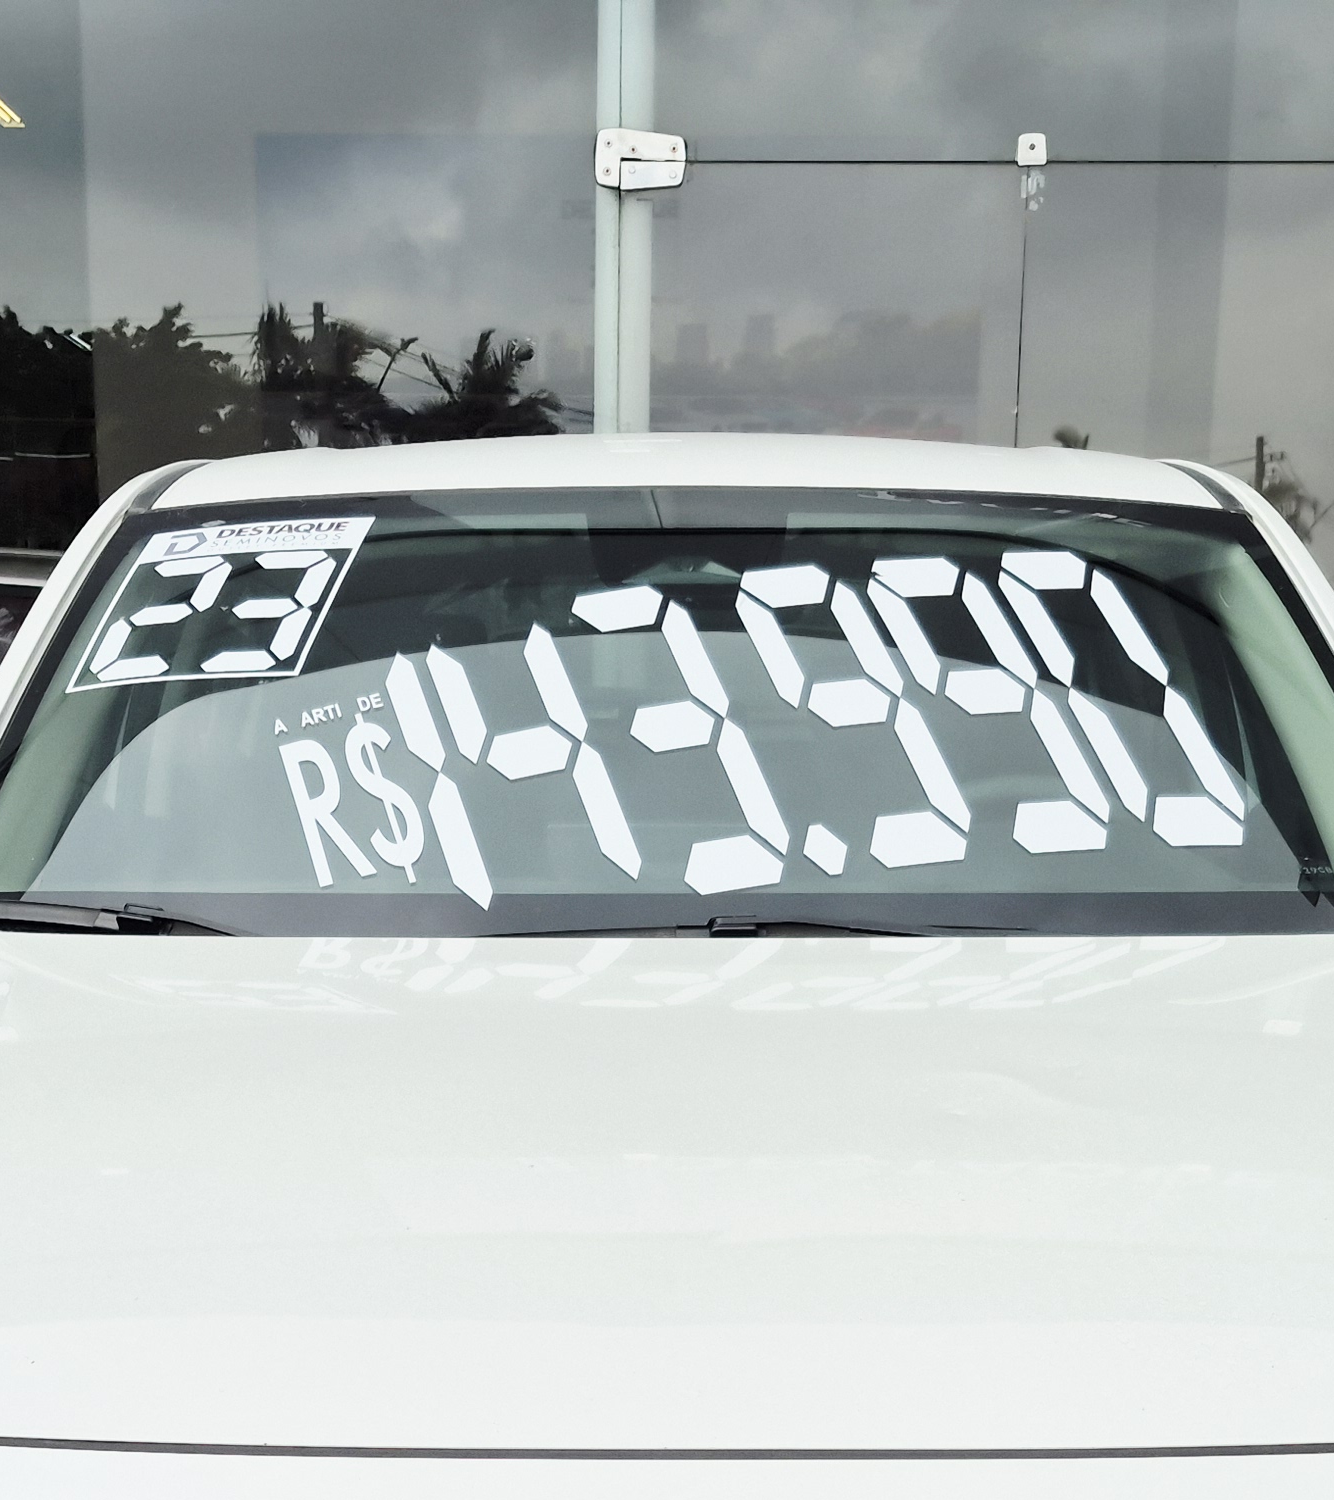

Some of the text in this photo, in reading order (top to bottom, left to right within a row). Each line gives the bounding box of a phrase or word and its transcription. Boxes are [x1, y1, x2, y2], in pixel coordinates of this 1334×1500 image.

[210, 533, 343, 548] SEMINOVOS
[216, 521, 350, 539] DESTAQUE
[89, 550, 337, 682] 23
[274, 718, 288, 735] A
[357, 693, 384, 712] DE
[279, 551, 1247, 910] R$ 143.990
